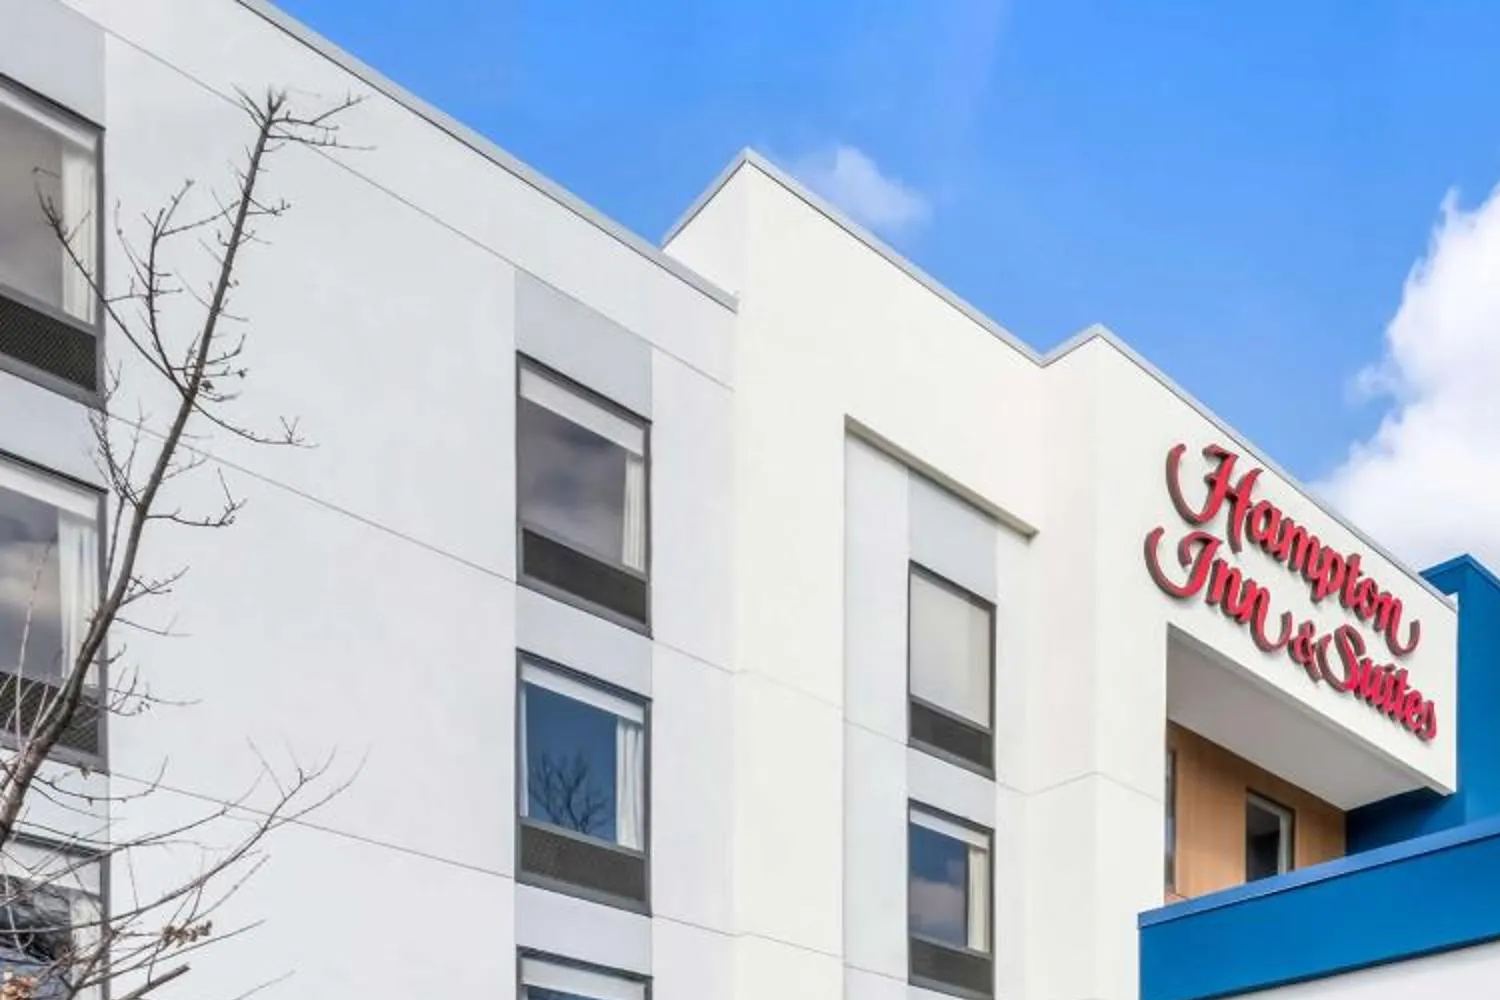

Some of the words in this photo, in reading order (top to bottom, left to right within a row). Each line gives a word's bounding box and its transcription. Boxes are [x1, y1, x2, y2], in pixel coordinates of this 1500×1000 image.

[1144, 525, 1293, 652] Inn
[1288, 619, 1322, 684] &
[1316, 623, 1437, 742] Suites
[1165, 443, 1421, 657] Hampton
